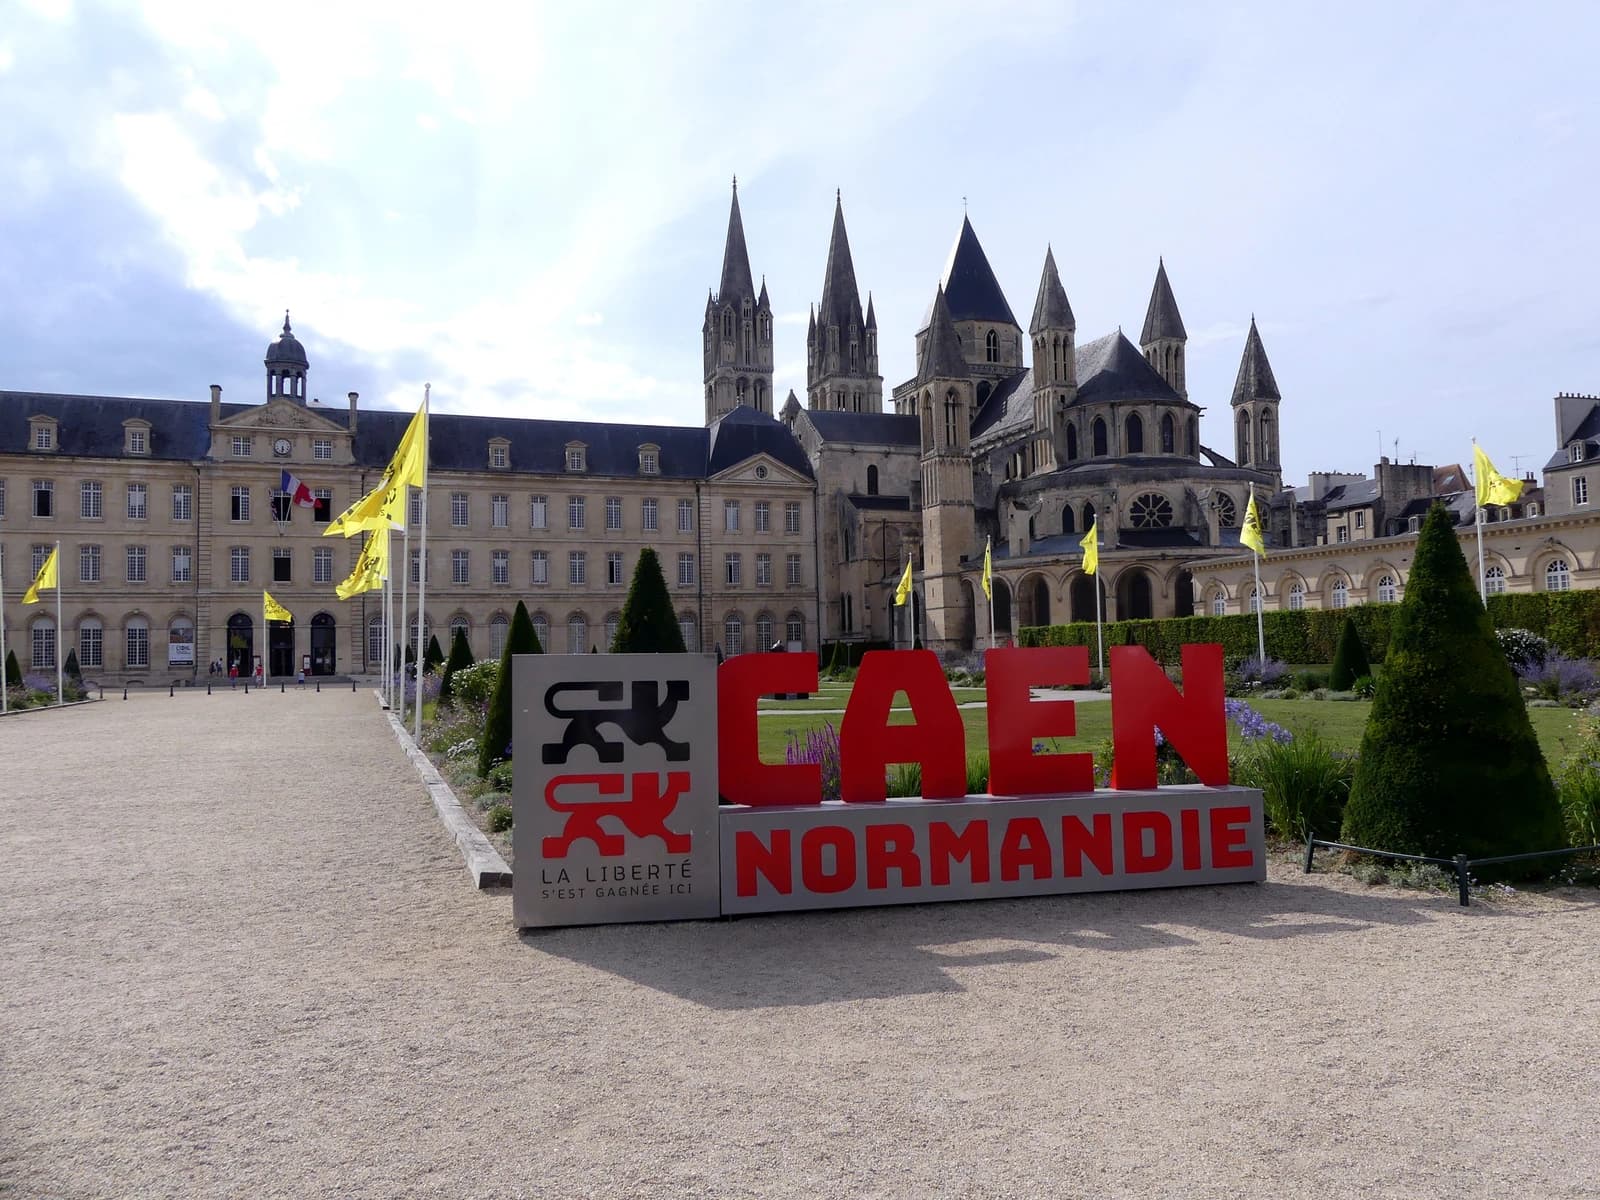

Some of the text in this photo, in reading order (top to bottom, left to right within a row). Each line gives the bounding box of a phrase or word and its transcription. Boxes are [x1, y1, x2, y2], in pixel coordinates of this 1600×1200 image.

[718, 643, 1229, 807] CAEN
[541, 859, 693, 885] LA LIBERTÉ
[735, 806, 1254, 897] NORMANDIE
[541, 883, 692, 900] S'EST GAGNÉE ICI
